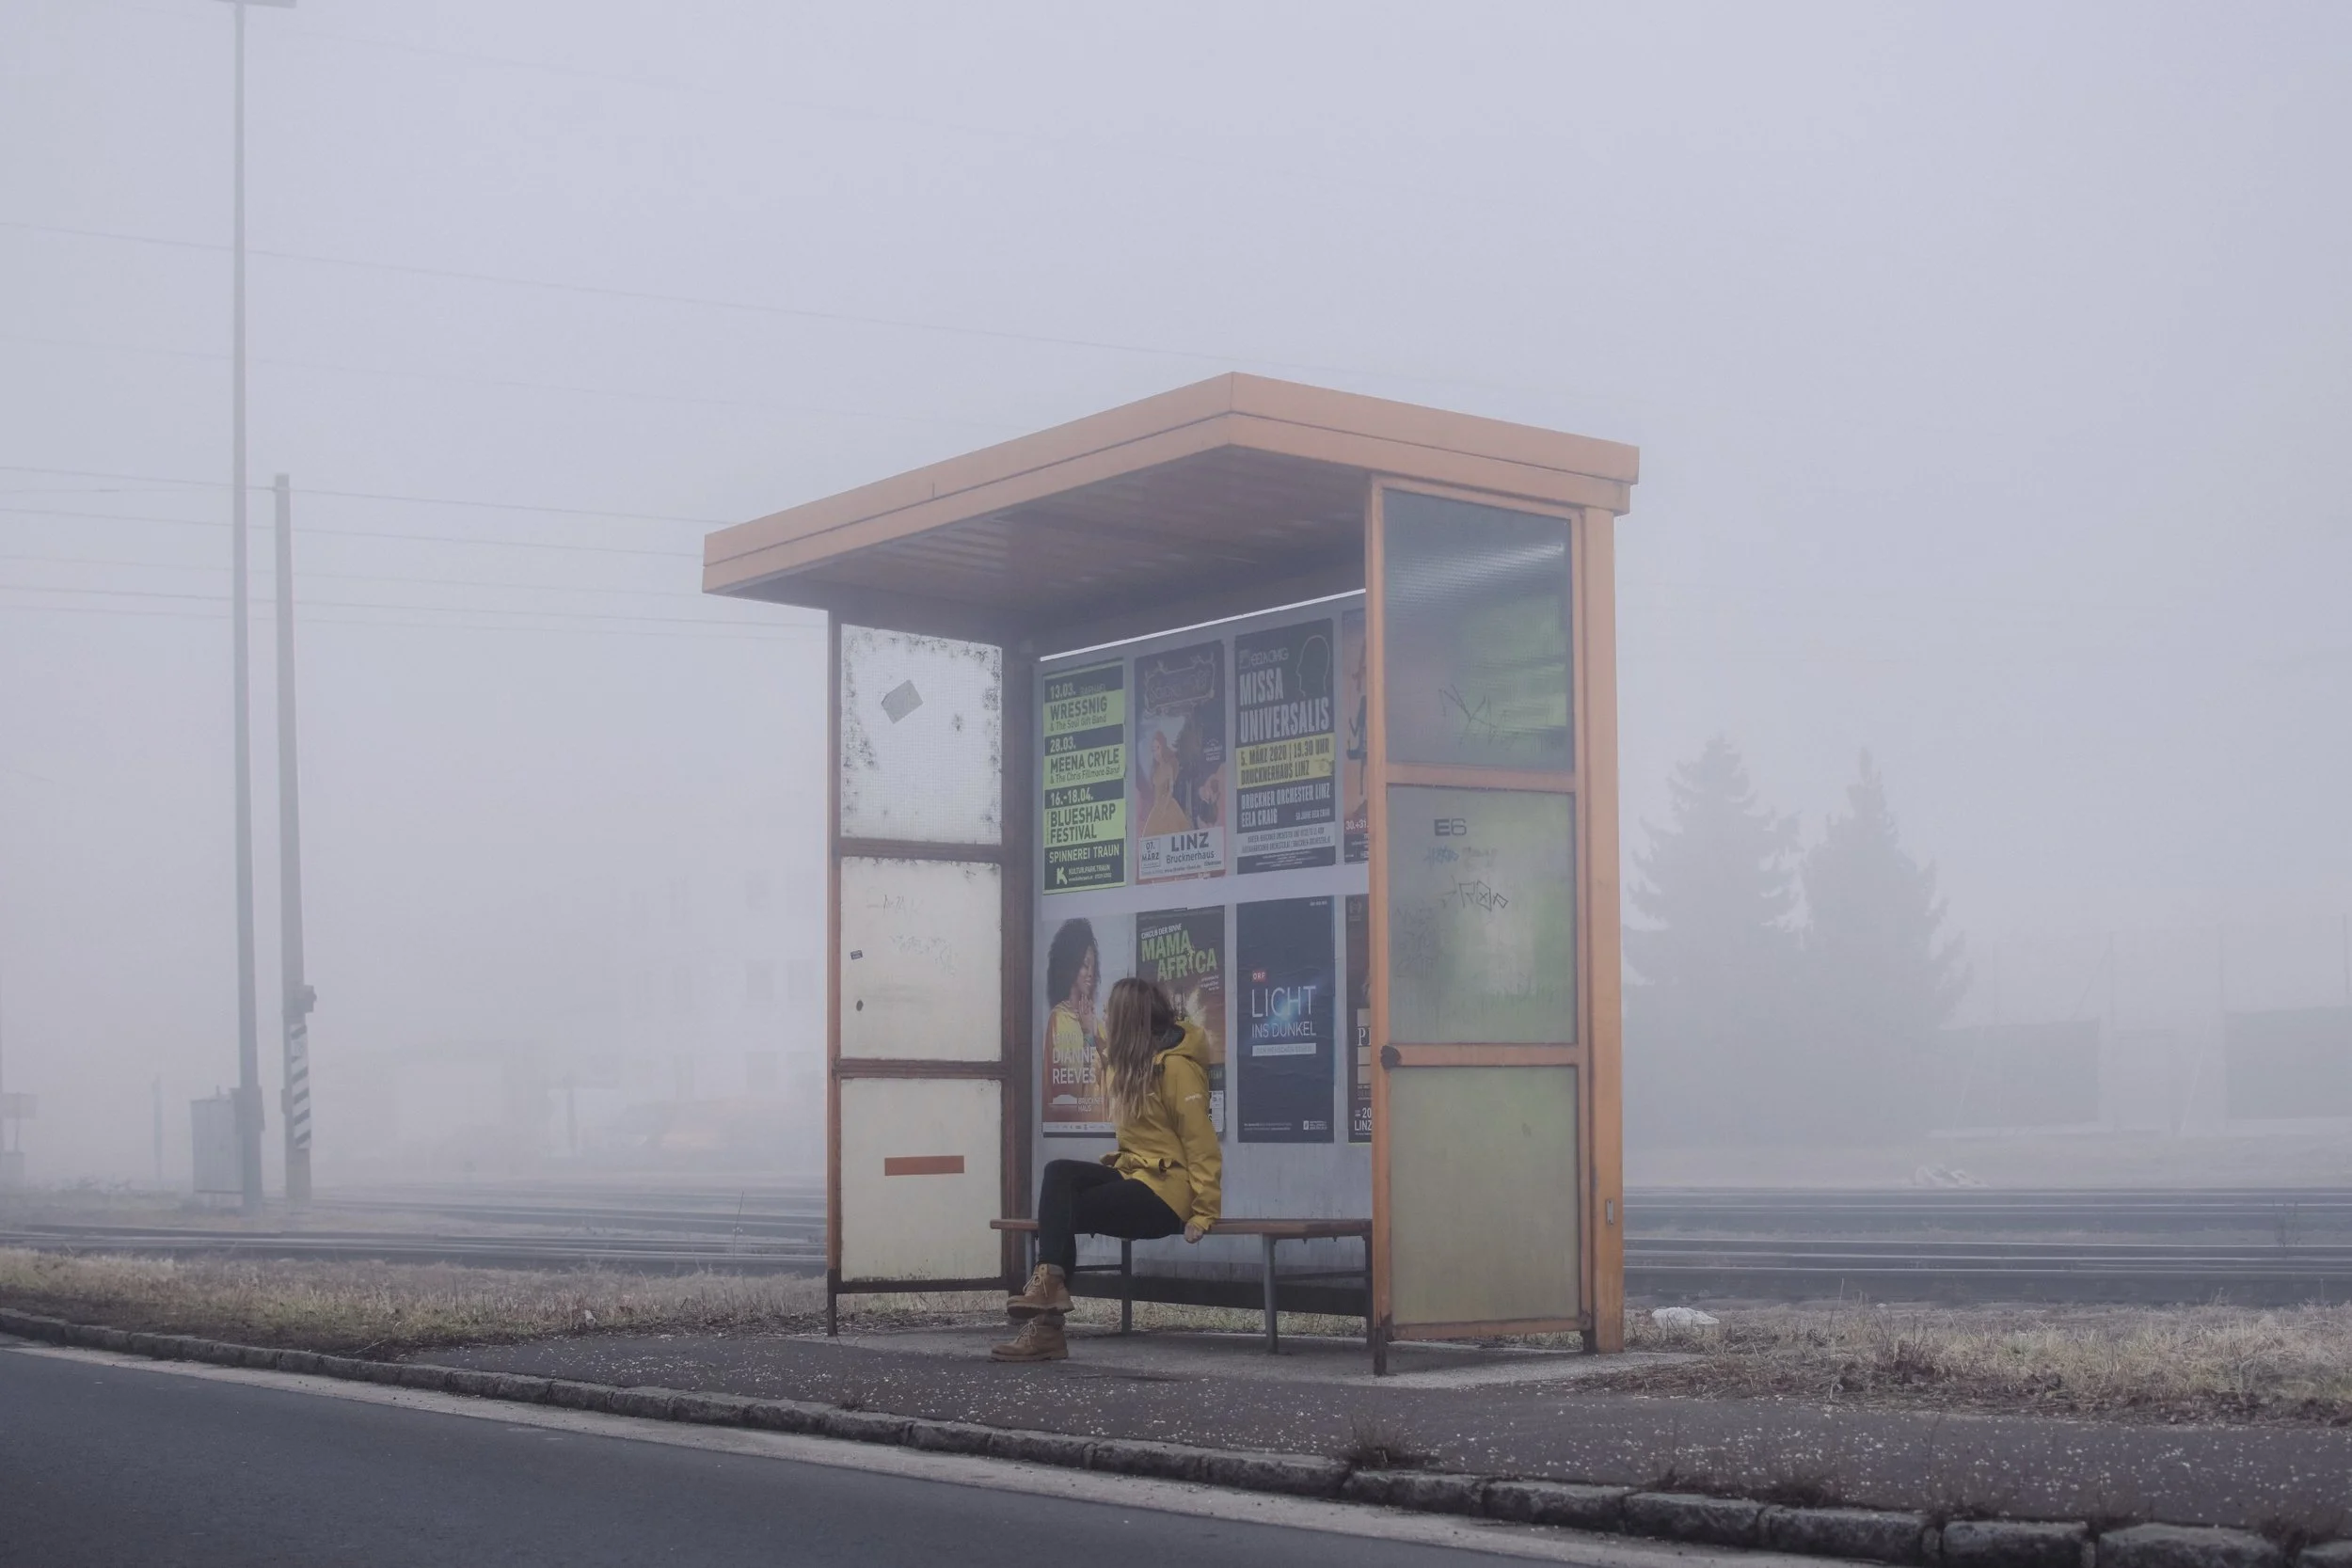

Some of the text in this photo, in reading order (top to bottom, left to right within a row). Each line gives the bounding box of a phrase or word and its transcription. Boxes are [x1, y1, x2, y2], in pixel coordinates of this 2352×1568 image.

[1050, 682, 1076, 700] 13.03.
[1240, 667, 1283, 706] MISSA
[1050, 696, 1107, 721] WRESSNIG
[1057, 721, 1066, 730] The
[1067, 717, 1080, 728] Soul
[1081, 716, 1091, 726] Gift
[1092, 714, 1107, 724] Band
[1240, 697, 1329, 743] UNIVERSALIS
[1050, 736, 1076, 753] 28.03.
[1241, 751, 1248, 767] 5.
[1270, 744, 1287, 762] 2020
[1315, 737, 1330, 755] UHR
[1050, 748, 1120, 774] MEENA CRYLE
[1056, 774, 1066, 783] The
[1067, 771, 1081, 782] Chris
[1105, 764, 1120, 775] Band
[1241, 759, 1310, 784] BRUCKNERHAUS LINZ
[1050, 786, 1093, 806] 16.-18.04.
[1242, 783, 1330, 810] BRUCKNER ORCHESTER LINZ
[1050, 803, 1116, 828] BLUESHARP
[1242, 808, 1278, 828] EELA CRAIG
[1050, 824, 1097, 844] FESTIVAL
[1434, 816, 1468, 837] E6
[1146, 841, 1155, 850] 07.
[1171, 832, 1210, 852] LINZ
[1049, 845, 1120, 863] SPINNEREI TRAUN
[1142, 850, 1159, 862] MÄRZ
[1167, 850, 1215, 864] Brucknerhaus
[1141, 929, 1158, 940] CIRCUS
[1159, 927, 1168, 935] DER
[1168, 924, 1183, 933] SINNE
[1141, 929, 1191, 962] MAMA
[1252, 972, 1266, 980] ORF
[1251, 986, 1316, 1018] LICHT
[1252, 1021, 1317, 1038] INS DUNKEL
[1052, 1046, 1097, 1065] DIANNE
[1052, 1067, 1097, 1085] REEVES
[1355, 1119, 1372, 1131] LINZ
